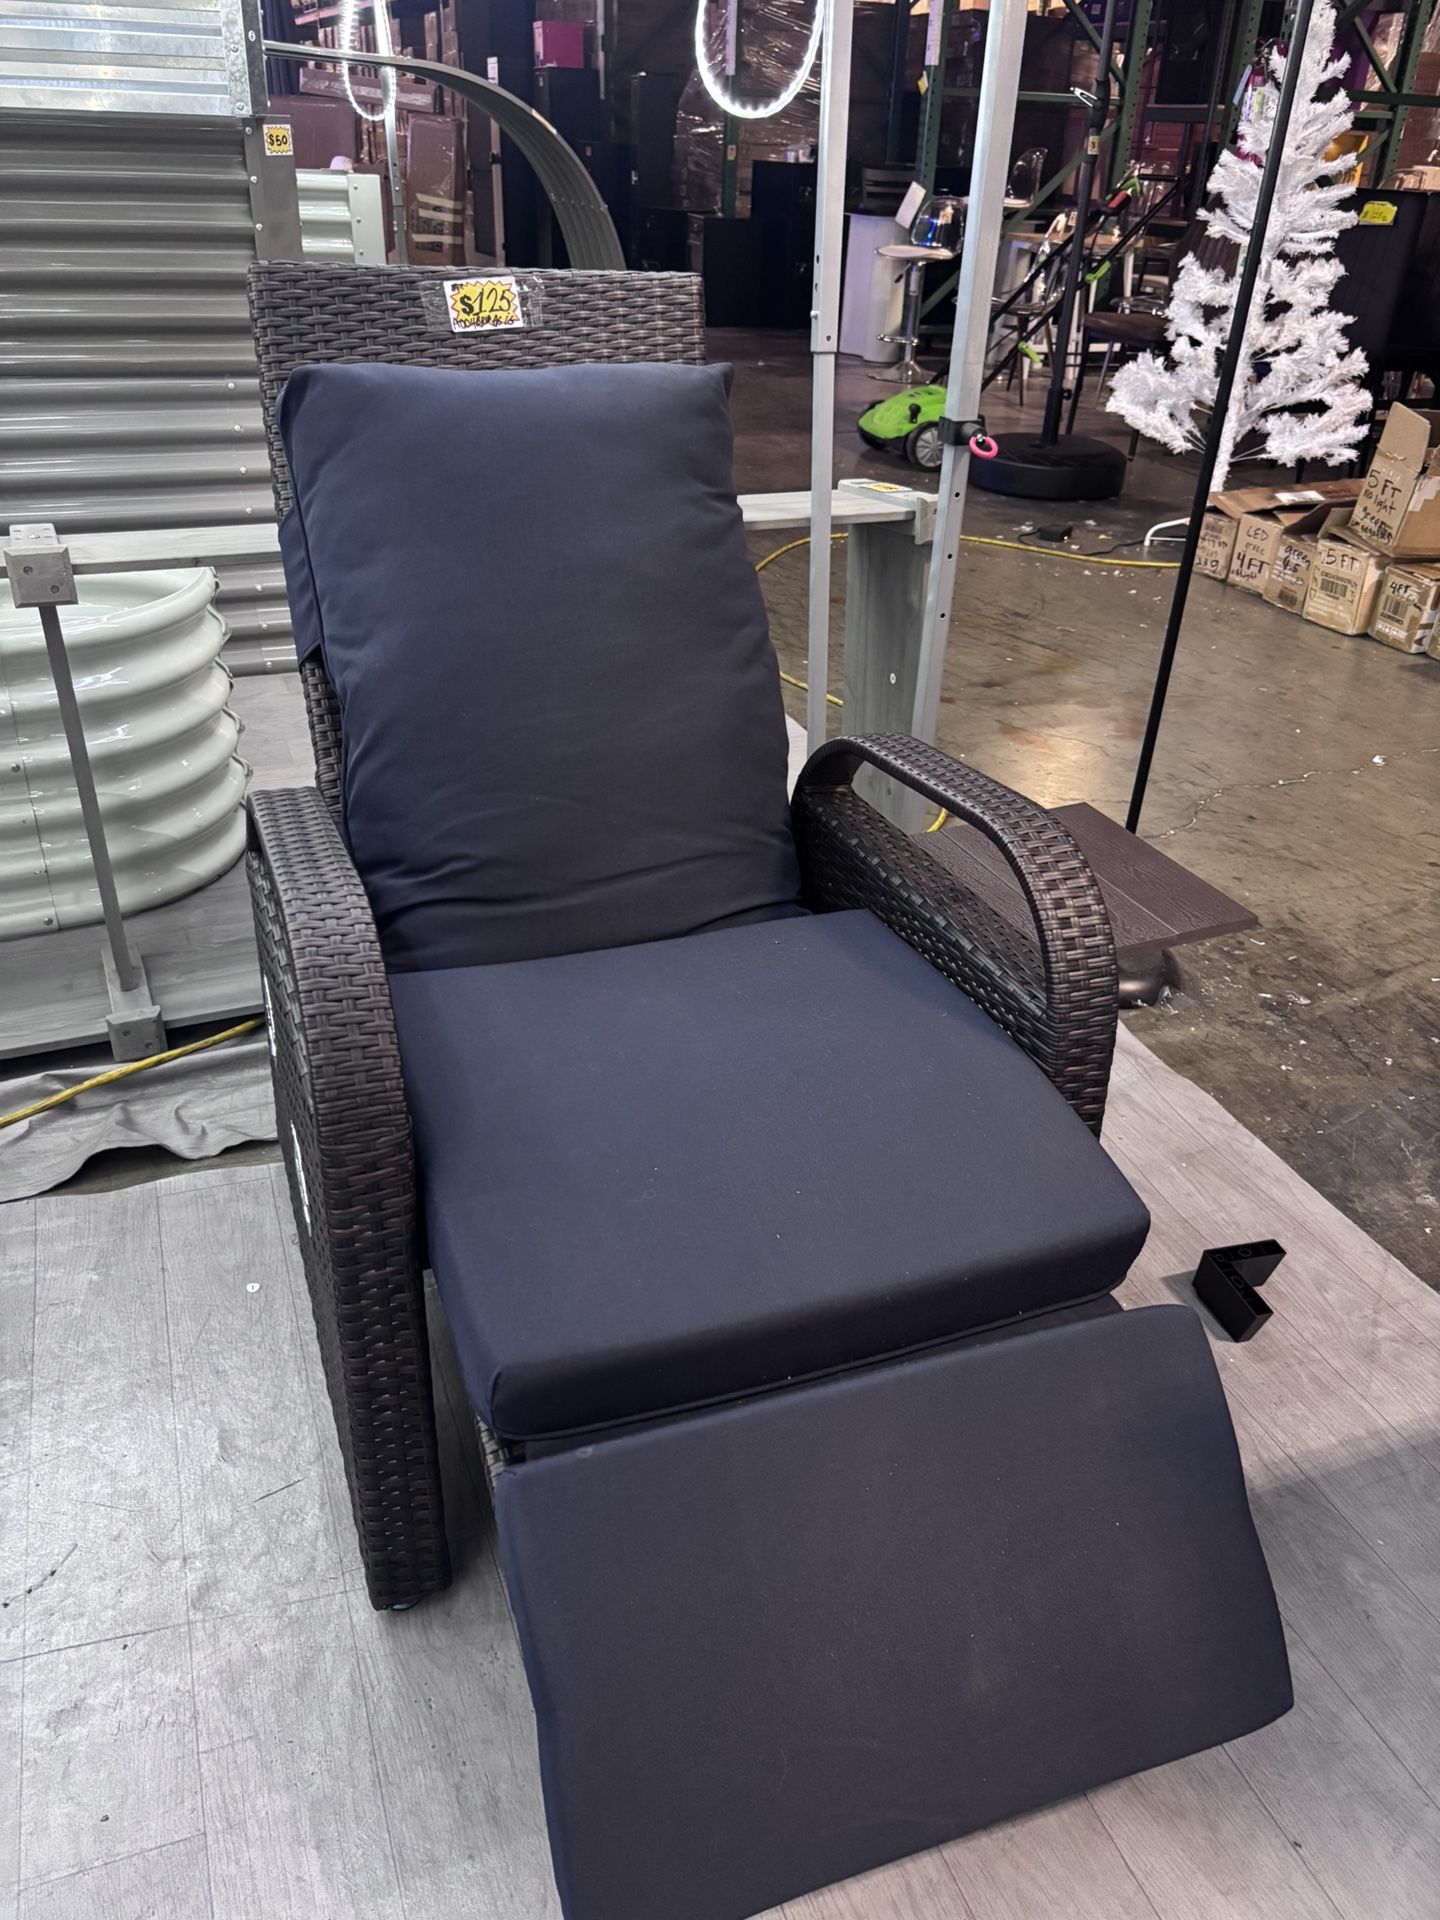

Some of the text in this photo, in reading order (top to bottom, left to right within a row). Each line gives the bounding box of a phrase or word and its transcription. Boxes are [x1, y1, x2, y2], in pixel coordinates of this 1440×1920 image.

[268, 133, 288, 147] $50
[459, 287, 511, 316] $125
[1367, 469, 1380, 488] 5
[1381, 479, 1402, 498] FT
[1246, 525, 1269, 541] LED
[1246, 557, 1271, 574] FT
[1284, 545, 1311, 571] green
[1325, 548, 1359, 571] 5 FT
